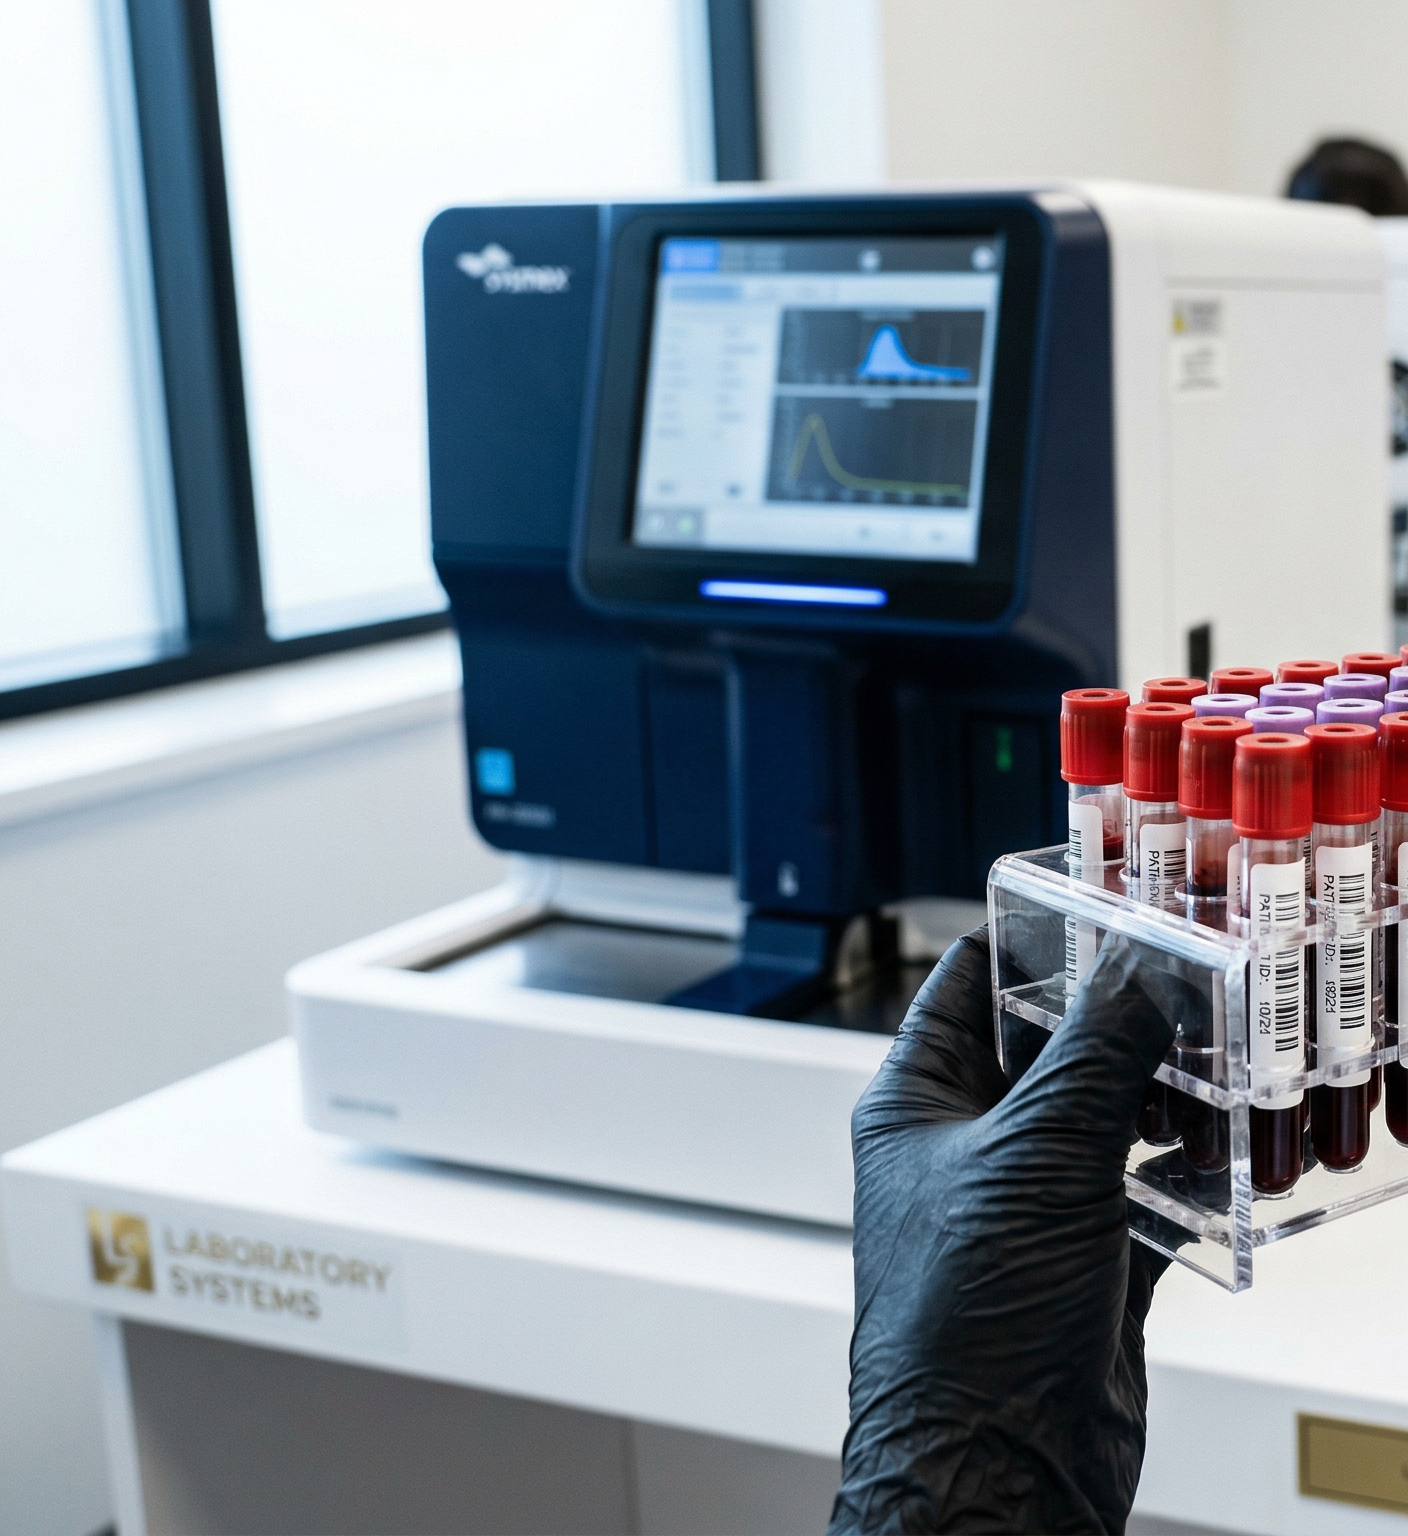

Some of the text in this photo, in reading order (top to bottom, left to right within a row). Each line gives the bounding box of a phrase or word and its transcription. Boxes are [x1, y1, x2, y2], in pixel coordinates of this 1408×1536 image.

[1259, 1001, 1271, 1035] 10/21
[163, 1225, 393, 1292] LABORATORY
[169, 1264, 321, 1322] SYSTEMS
